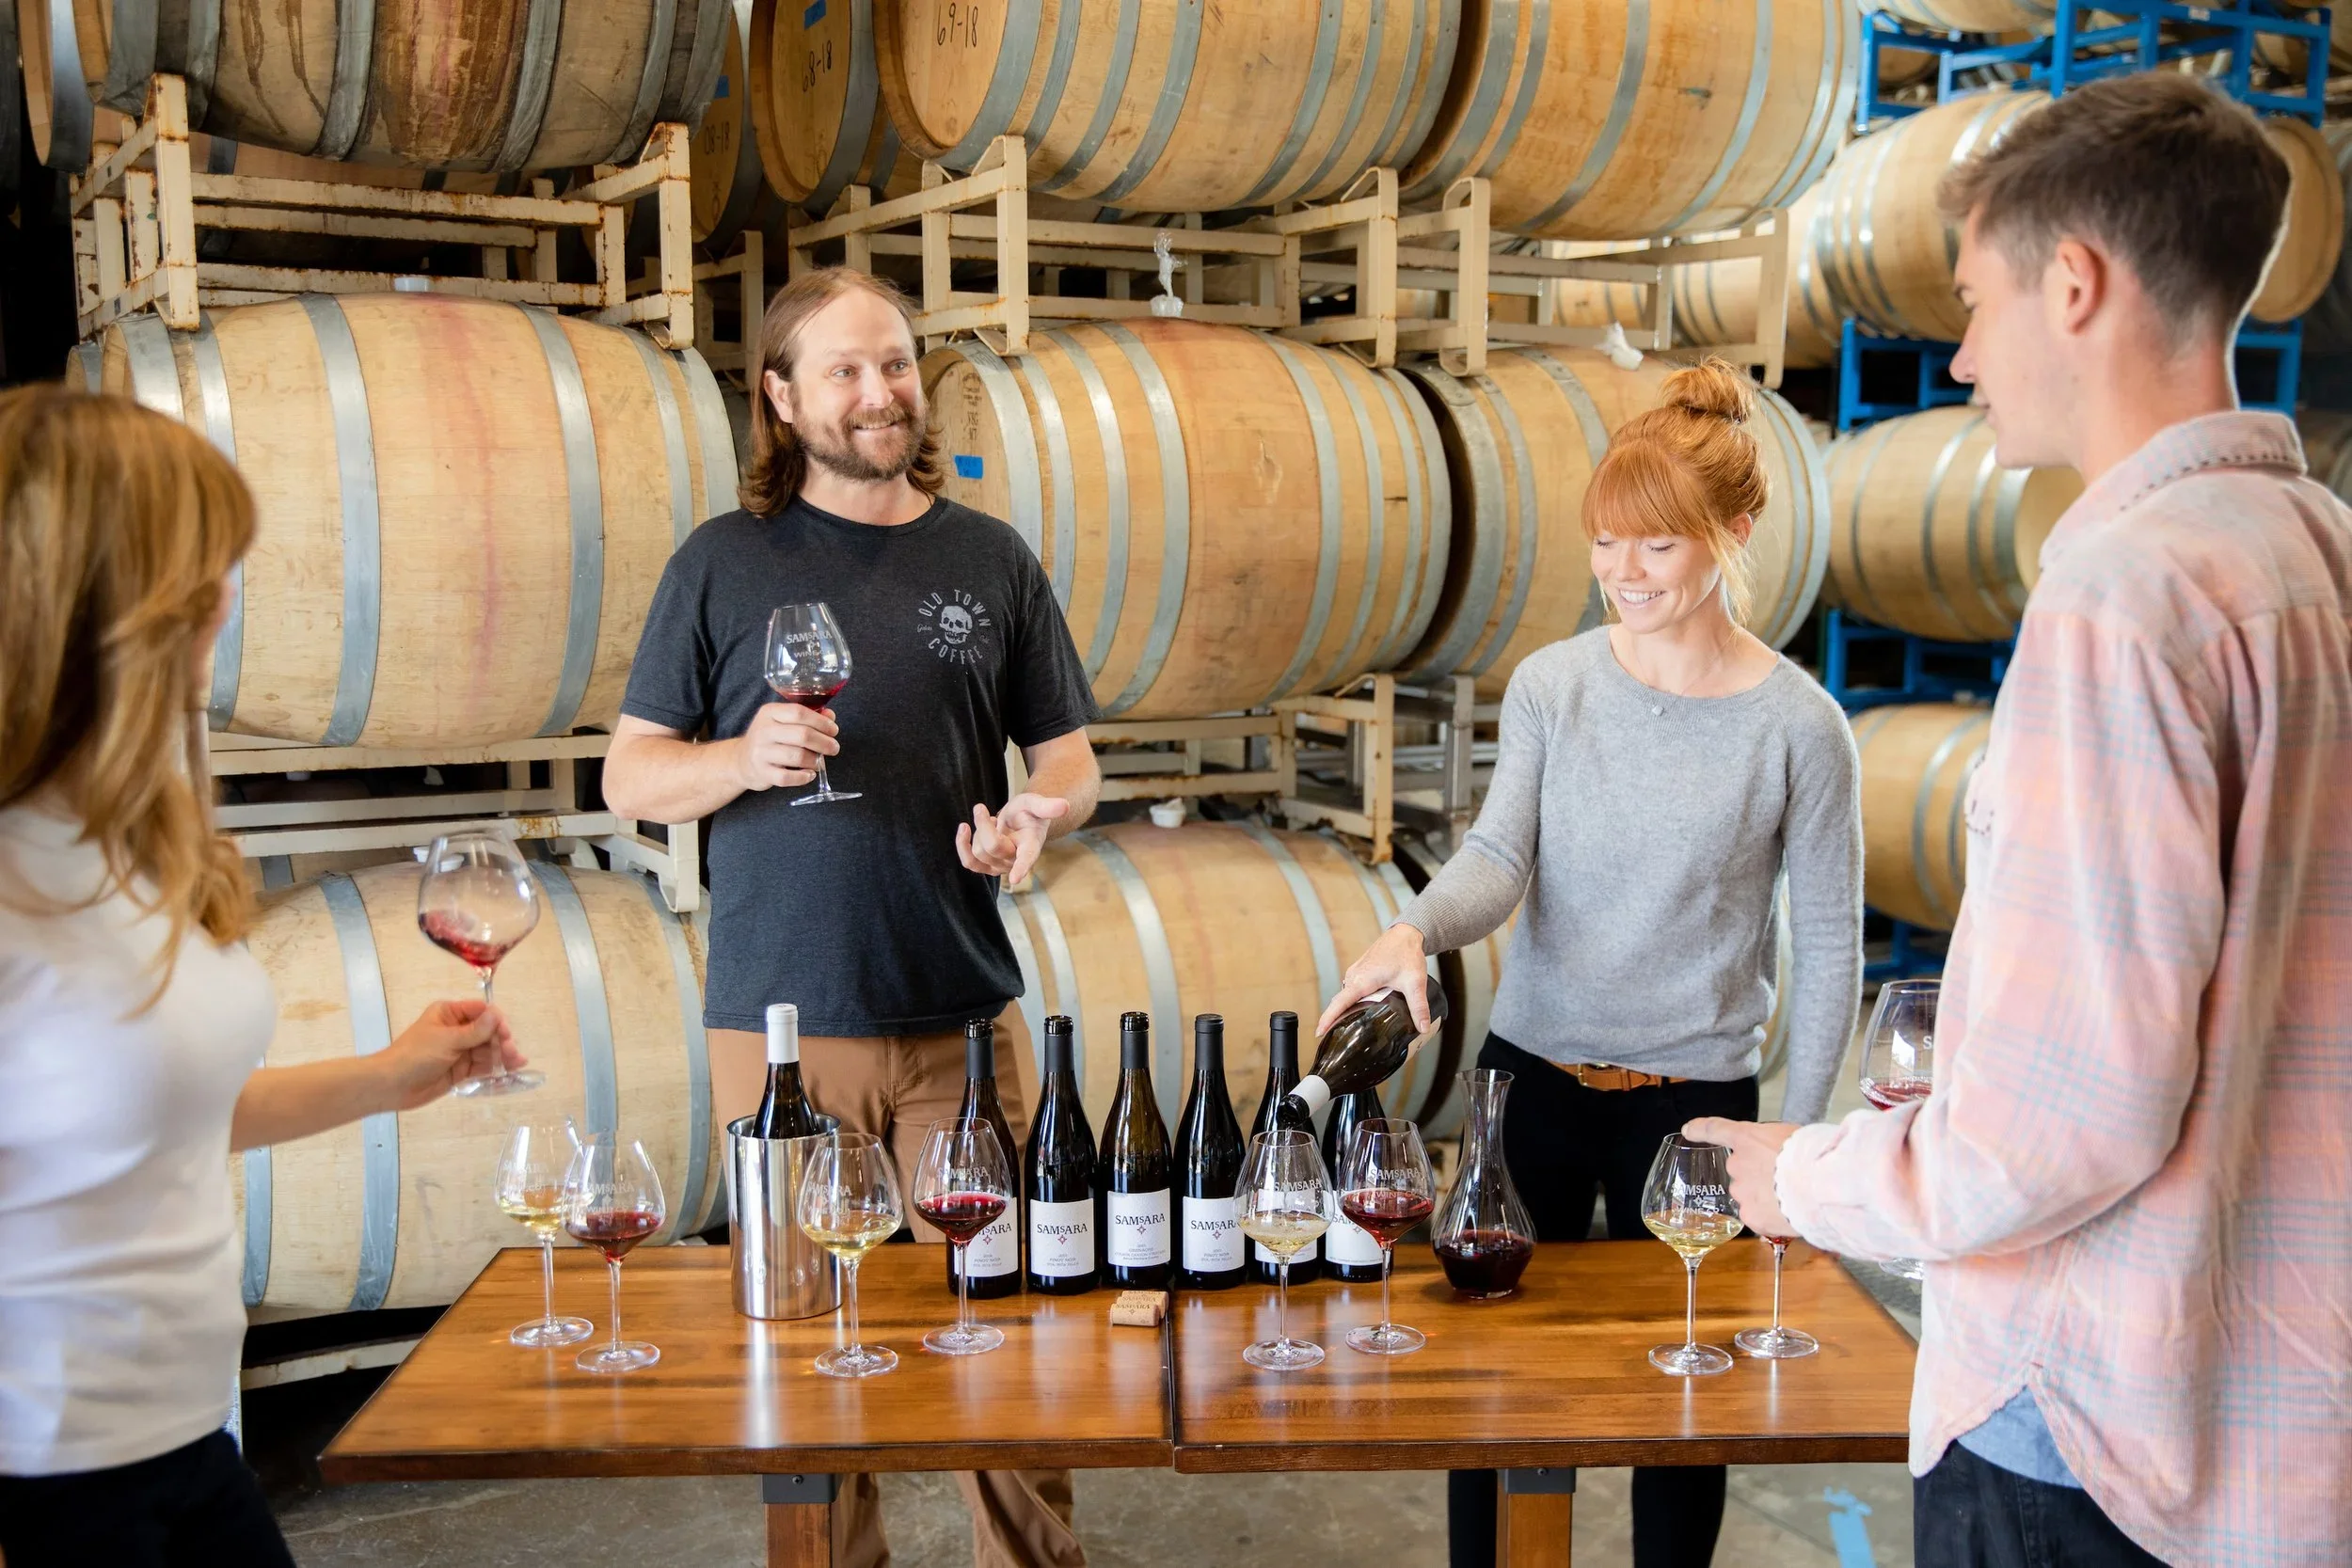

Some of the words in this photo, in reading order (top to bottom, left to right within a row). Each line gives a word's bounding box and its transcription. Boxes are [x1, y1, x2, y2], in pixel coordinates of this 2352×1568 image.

[937, 2, 978, 48] 69-18
[802, 40, 833, 92] 68-18
[918, 592, 943, 617] OLD
[954, 589, 991, 626] TOWN
[928, 638, 983, 665] COFFEE
[1370, 1166, 1421, 1180] SAMSARA
[1037, 1223, 1088, 1235] SAMSARA
[1115, 1213, 1166, 1226] SAMSARA
